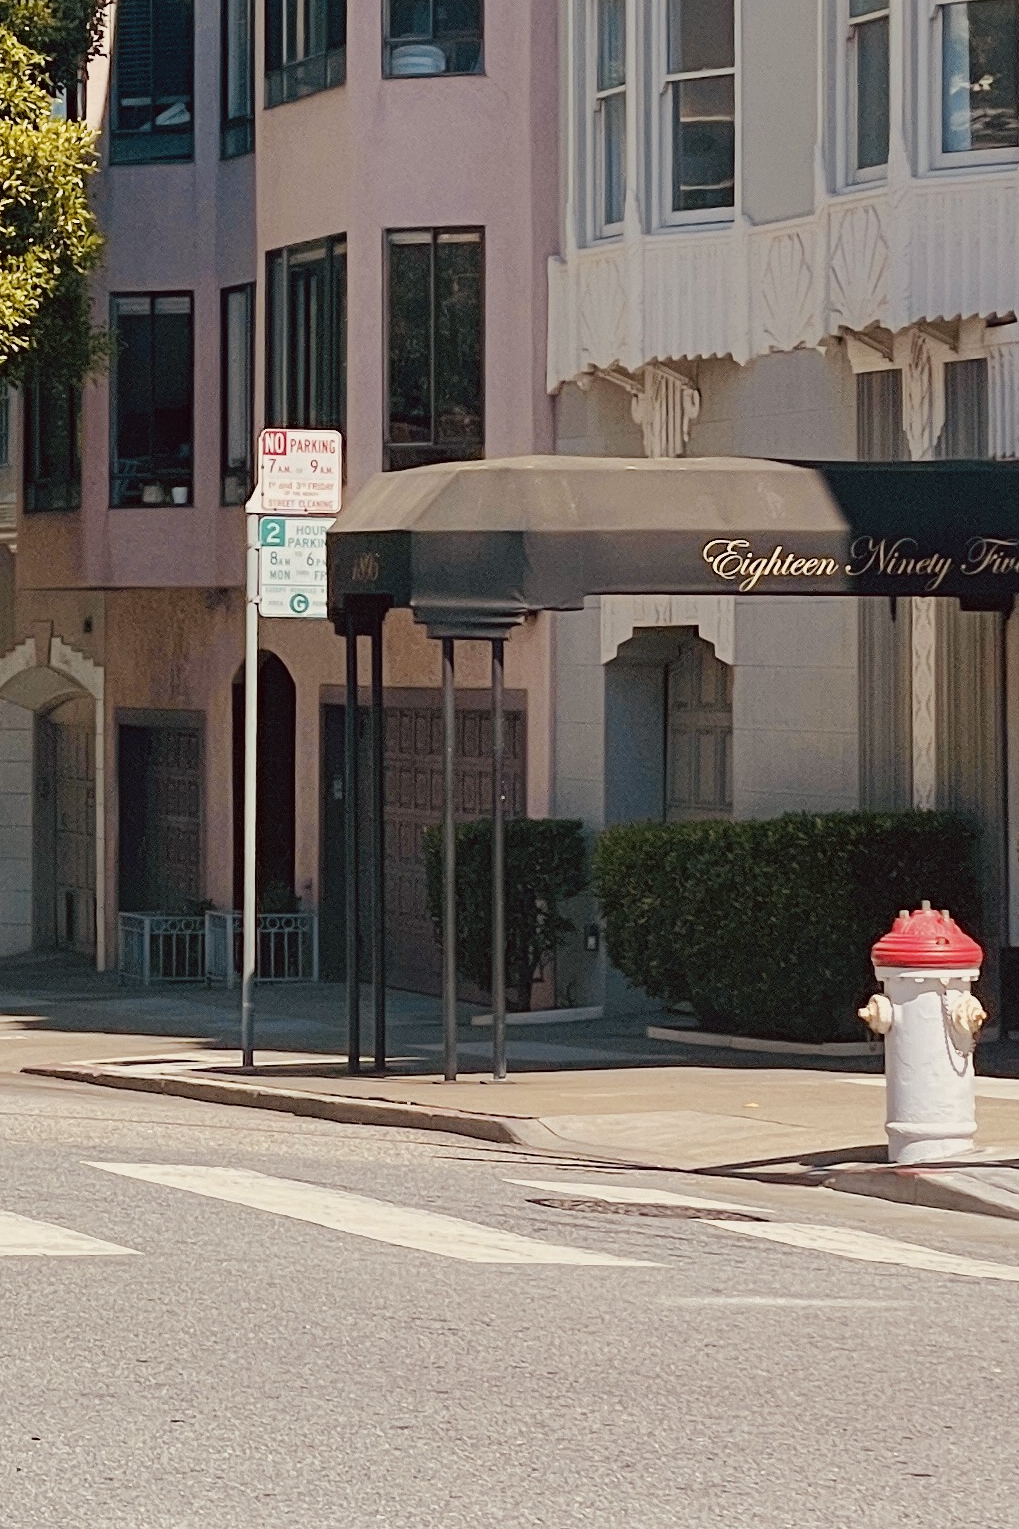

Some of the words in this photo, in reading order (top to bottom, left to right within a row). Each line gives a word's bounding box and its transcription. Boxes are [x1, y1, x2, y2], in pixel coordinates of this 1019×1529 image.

[264, 432, 285, 454] NO
[290, 438, 336, 454] PARKING
[268, 458, 277, 473] 7
[310, 459, 319, 473] 9
[268, 499, 295, 508] STREET
[298, 500, 333, 509] CLEANING
[266, 522, 280, 543] 2
[270, 551, 278, 565] 8
[306, 552, 315, 566] 6
[702, 539, 839, 592] Eighteen
[846, 537, 953, 590] Ninety
[270, 570, 291, 579] MON
